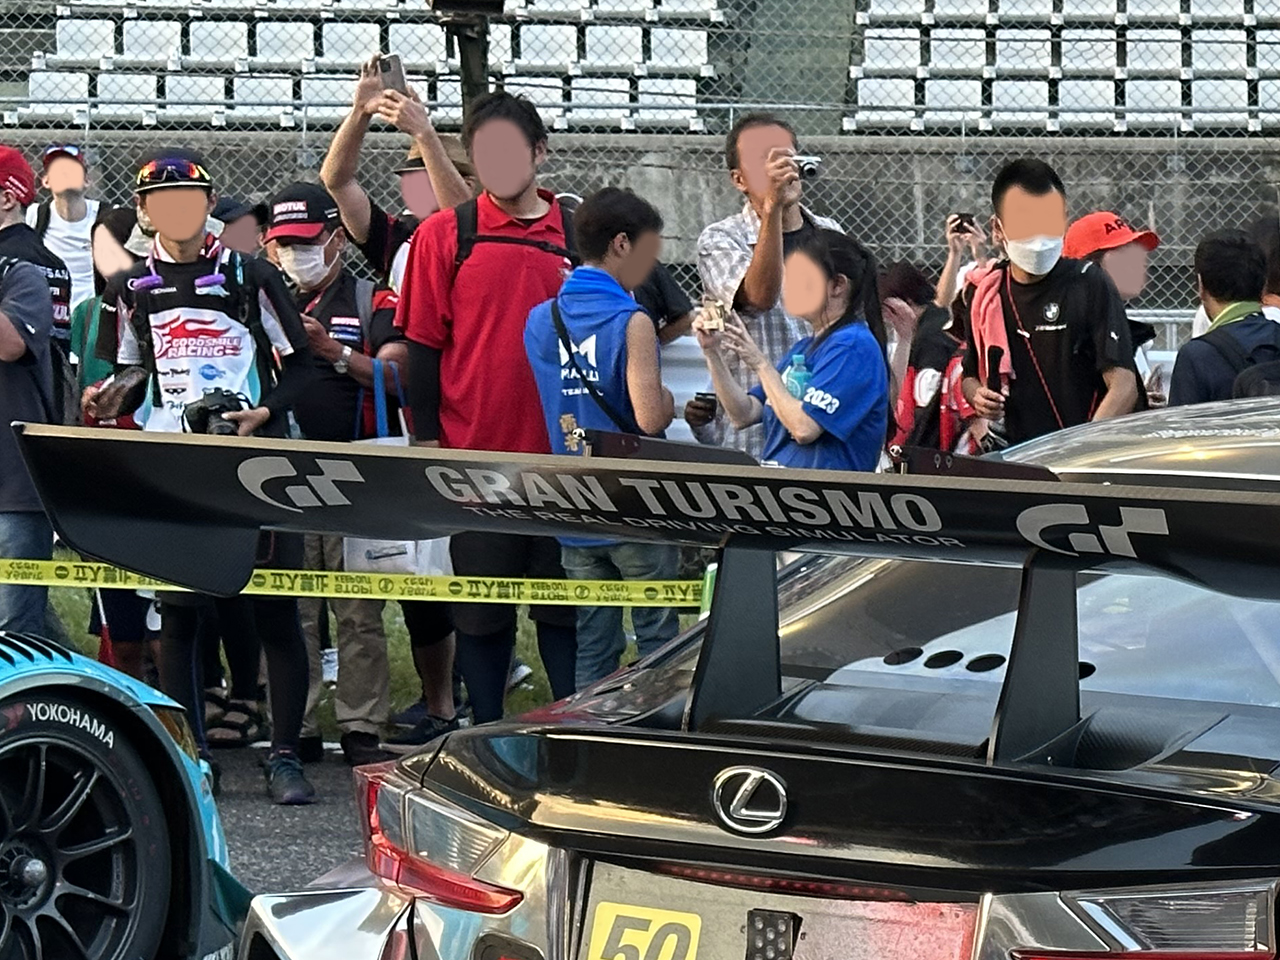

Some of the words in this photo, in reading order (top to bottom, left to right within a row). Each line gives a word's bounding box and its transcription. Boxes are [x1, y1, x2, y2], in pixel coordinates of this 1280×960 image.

[167, 346, 224, 358] RACING
[803, 386, 840, 415] 2023
[425, 465, 627, 512] GRAN
[619, 478, 943, 532] TURISMO
[462, 506, 531, 520] THE
[533, 511, 622, 526] REAL
[622, 517, 762, 535] DRIVING
[765, 526, 966, 547] SIMULATOR
[26, 703, 117, 749] YOKOHAMA
